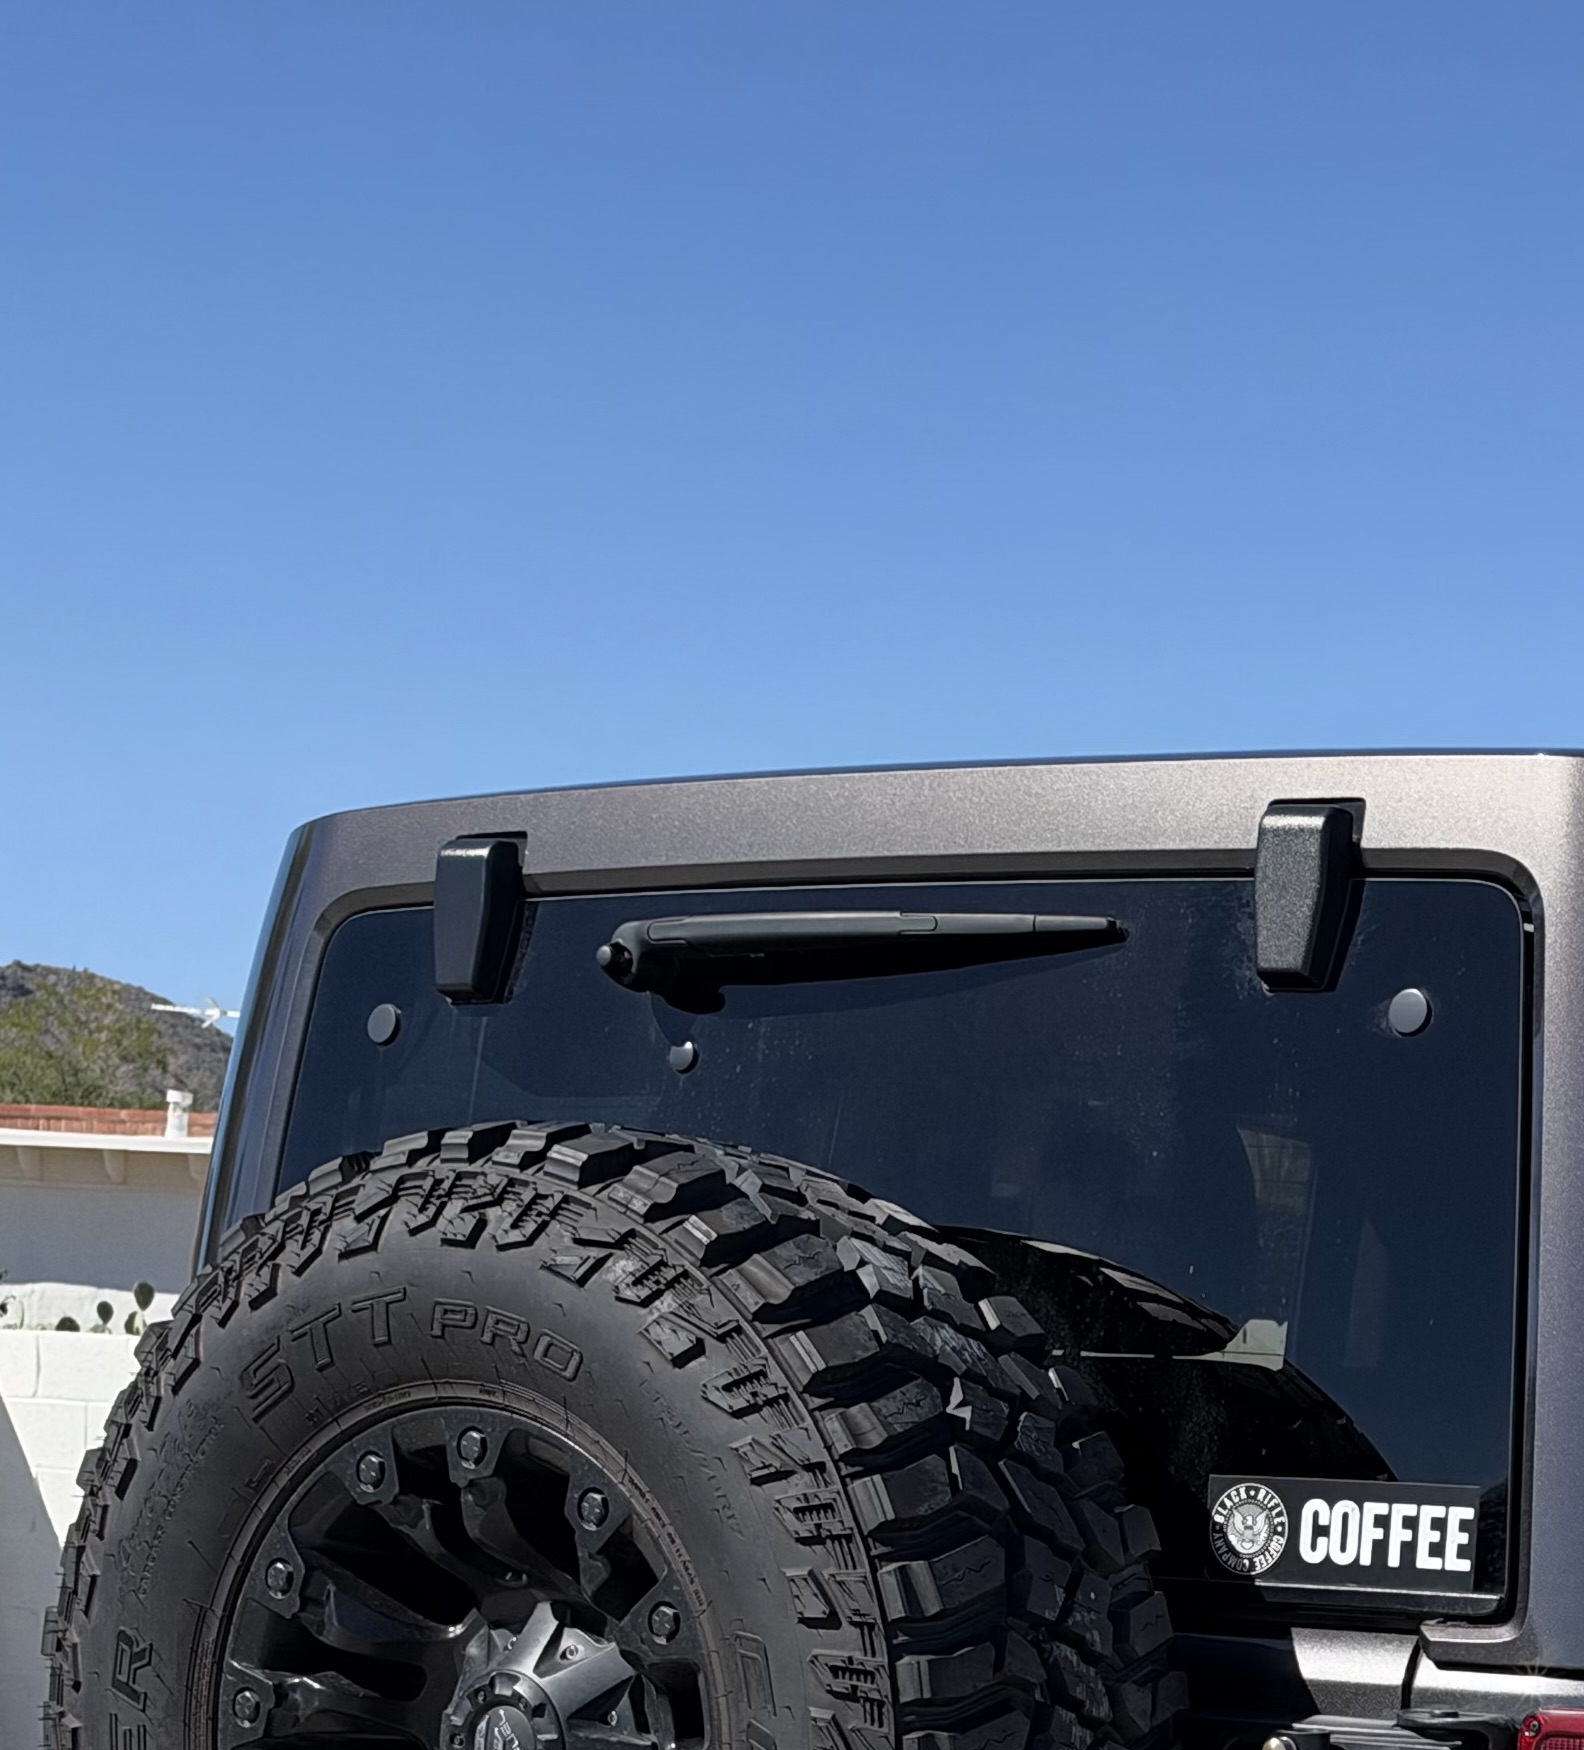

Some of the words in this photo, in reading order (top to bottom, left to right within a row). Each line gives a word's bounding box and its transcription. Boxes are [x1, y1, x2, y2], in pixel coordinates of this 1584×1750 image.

[239, 1286, 407, 1423] STT
[429, 1298, 584, 1382] PRO
[1213, 1486, 1249, 1523] BLACK
[1257, 1487, 1285, 1525] RIFLE
[1213, 1531, 1250, 1572] COMPANY
[1253, 1534, 1284, 1572] COFFEE
[1299, 1498, 1476, 1573] COFFEE
